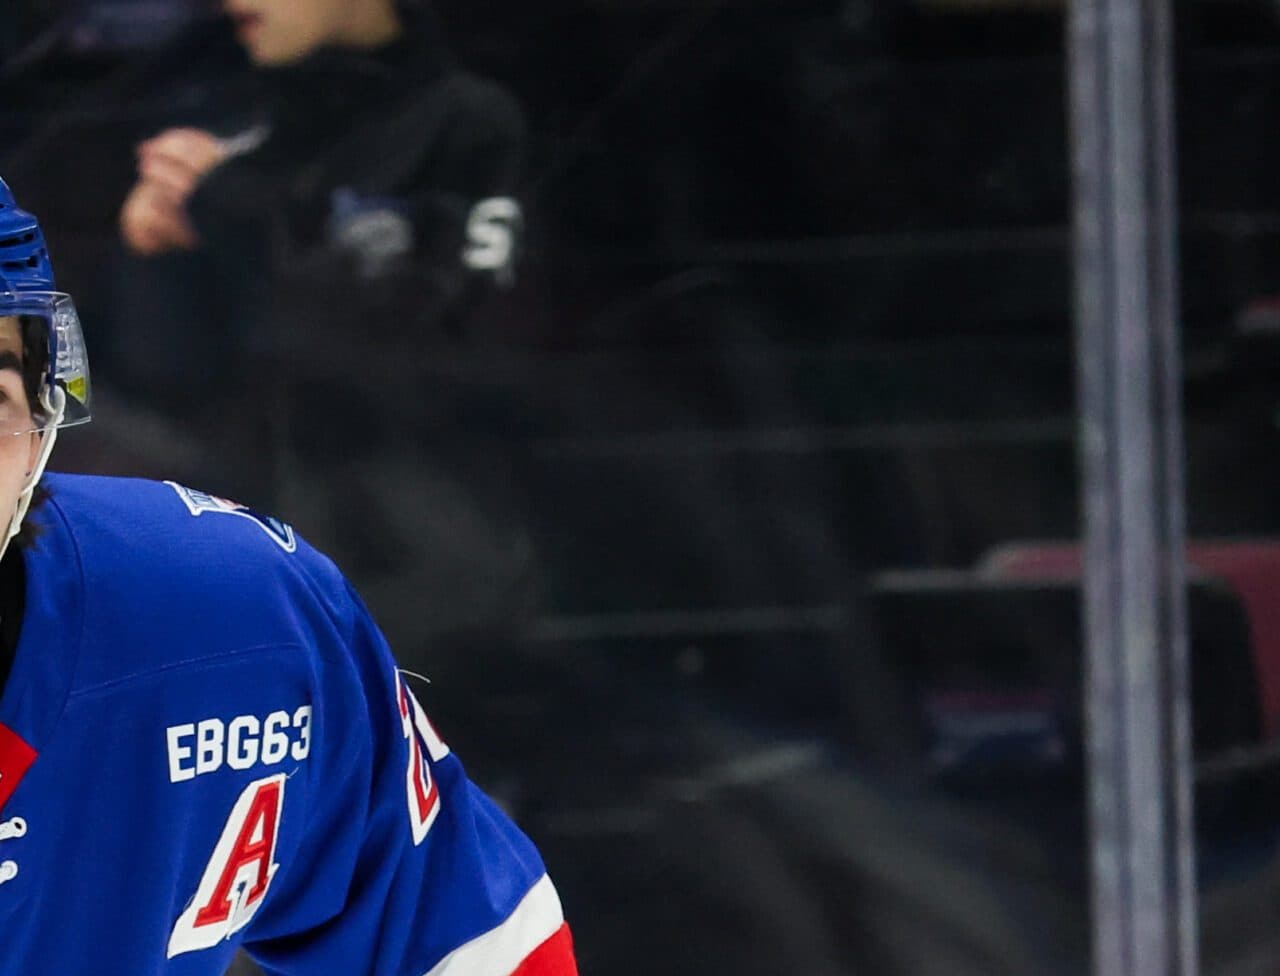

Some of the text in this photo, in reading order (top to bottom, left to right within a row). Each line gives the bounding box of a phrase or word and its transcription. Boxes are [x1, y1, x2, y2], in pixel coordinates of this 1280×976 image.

[166, 705, 313, 783] EBG63
[394, 665, 450, 847] 2
[166, 773, 280, 959] A
